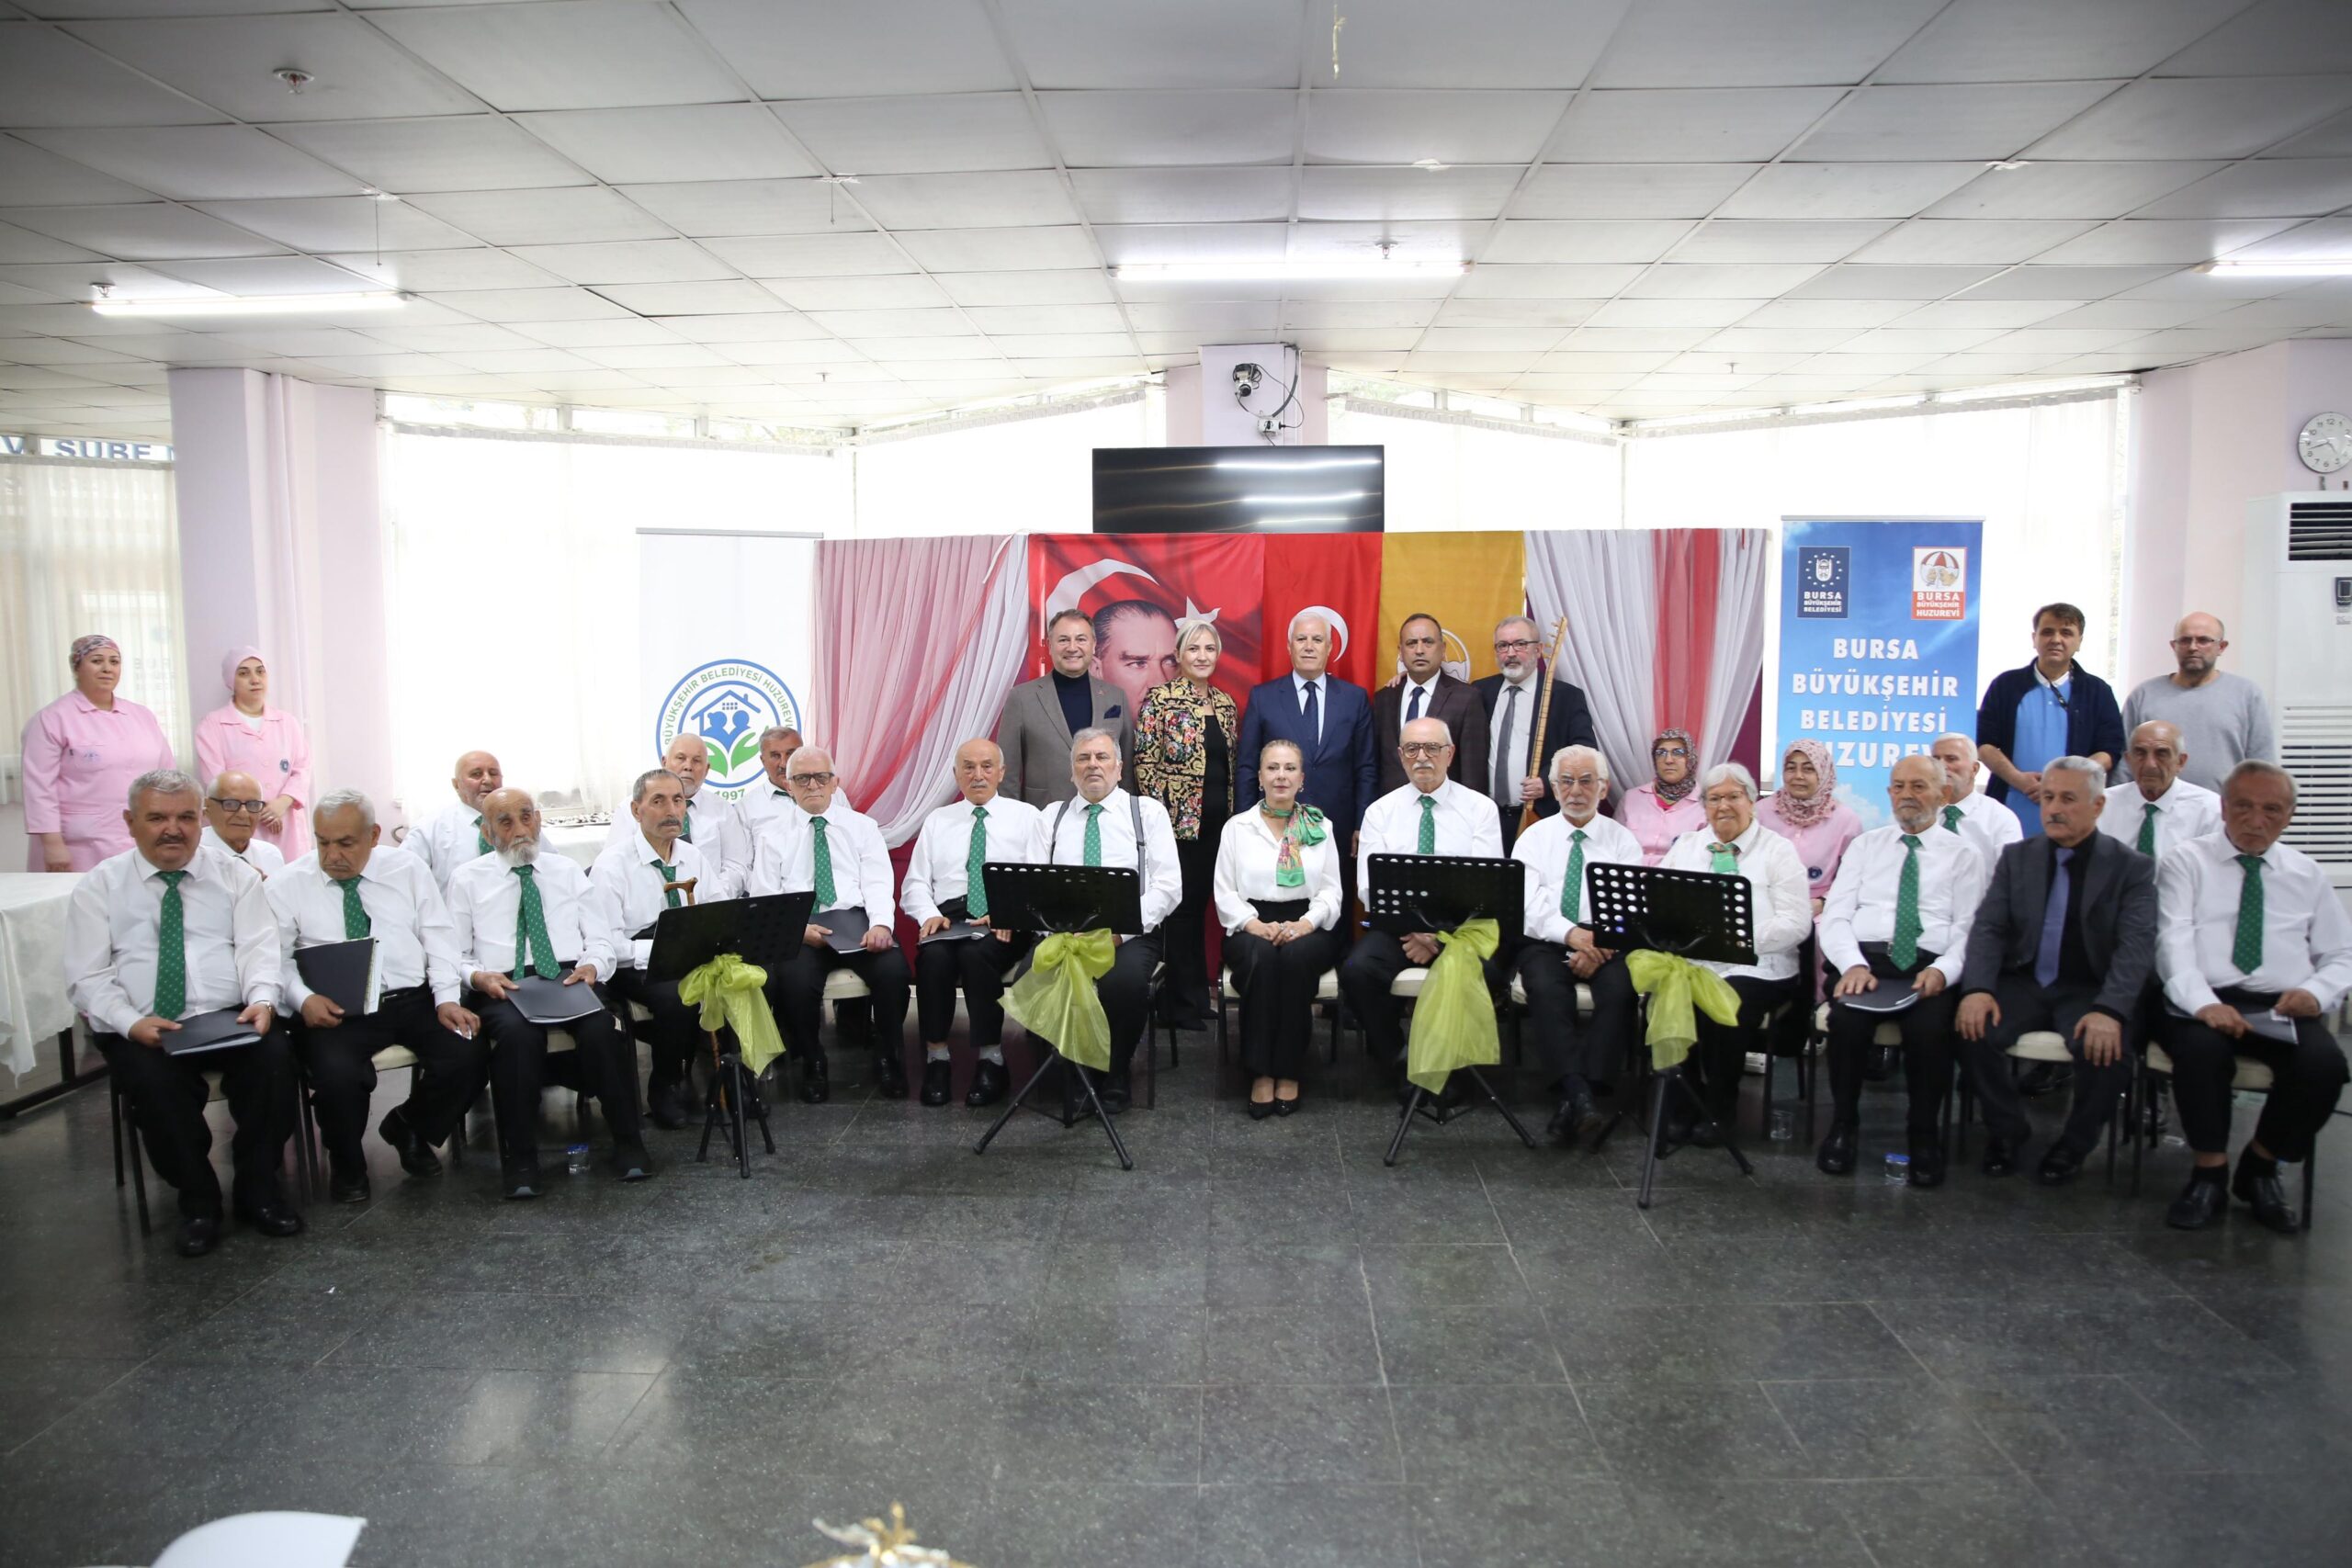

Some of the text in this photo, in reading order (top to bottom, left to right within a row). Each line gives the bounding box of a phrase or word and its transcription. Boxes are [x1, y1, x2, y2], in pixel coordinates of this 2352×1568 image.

[1804, 591, 1842, 600] BURSA
[1917, 592, 1960, 601] BURSA
[1833, 637, 1919, 660] BURSA
[700, 665, 763, 683] BELEDİYESİ
[1792, 668, 1959, 702] BÜYÜKŞEHİR
[1800, 705, 1947, 734] BELEDİYESİ
